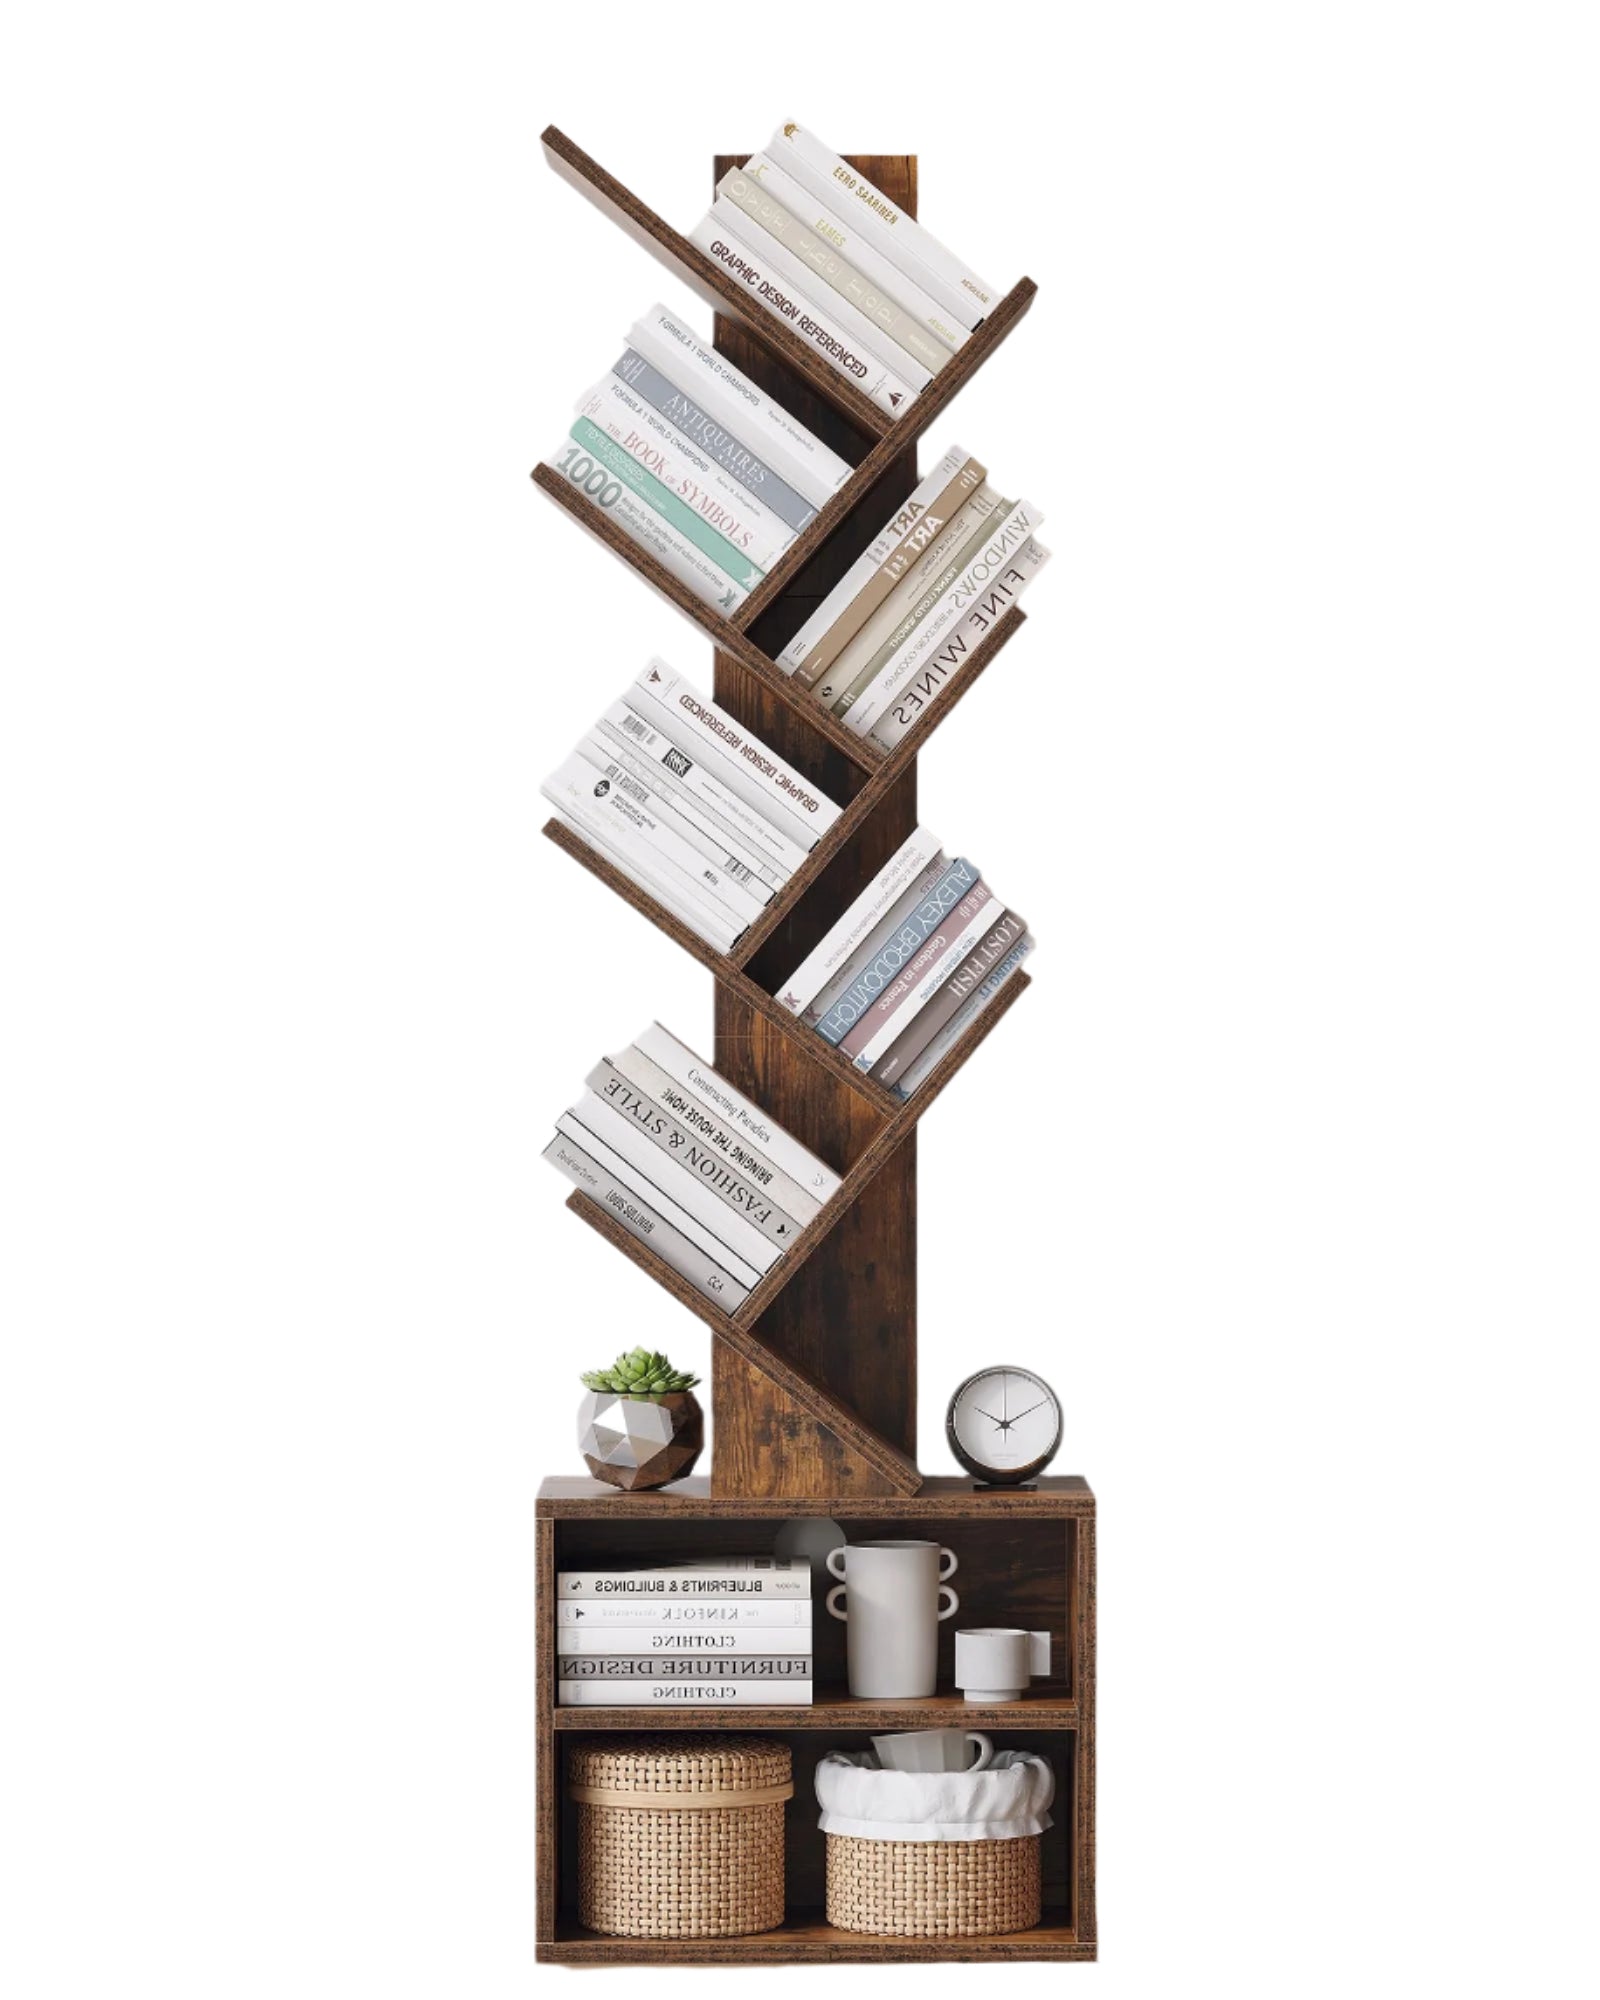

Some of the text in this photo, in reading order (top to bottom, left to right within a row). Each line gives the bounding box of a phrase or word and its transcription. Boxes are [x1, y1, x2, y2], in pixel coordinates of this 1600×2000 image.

[813, 217, 847, 248] EAMES
[707, 238, 762, 287] GRAPHIC
[755, 279, 801, 321] DESIGN
[794, 313, 870, 380] REFERENCED
[656, 315, 694, 349] FORMULA
[693, 347, 723, 374] WORLD
[717, 367, 762, 408] CHAMPIONS
[608, 383, 645, 416] FORMULA
[644, 414, 674, 441] WORLD
[667, 435, 712, 474] CHAMPIONS
[662, 390, 771, 486] ANTIQUAIRES
[553, 443, 627, 512] 1000
[620, 429, 671, 476] BOOK
[674, 476, 756, 549] SYMBOLS
[677, 692, 821, 814] GRAPHIC DESIGN REFERENCED
[911, 862, 975, 933] ALEXEY
[975, 914, 1022, 964] LOST
[825, 925, 922, 1035] BRODOVITCH
[876, 931, 948, 1014] Gardens in France
[945, 954, 987, 1000] FISH
[976, 939, 1030, 1000] MAKING IT
[659, 1086, 774, 1186] BRINGING THE HOUSE HOME
[683, 1066, 741, 1118] Constructing
[601, 1076, 773, 1224] FASHION & STYLE
